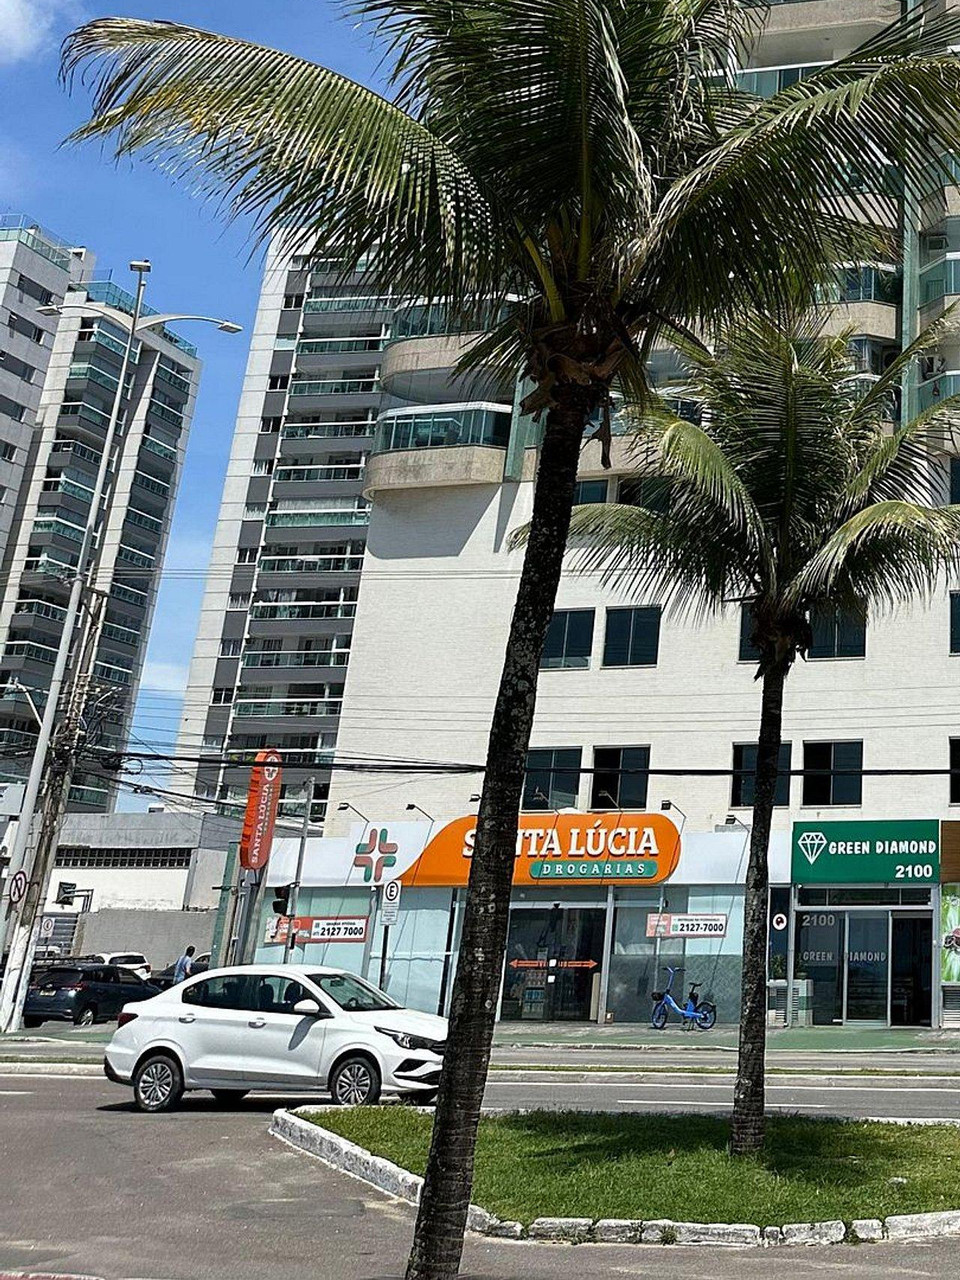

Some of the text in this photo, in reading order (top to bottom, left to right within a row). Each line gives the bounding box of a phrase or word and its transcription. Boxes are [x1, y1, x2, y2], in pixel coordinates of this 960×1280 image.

[251, 822, 264, 863] SANTA
[258, 783, 270, 820] LÚCIA
[462, 820, 659, 856] STA LÚCIA
[828, 840, 937, 854] GREEN DIAMOND
[542, 863, 646, 875] DROGARIAS
[895, 864, 933, 878] 2100
[388, 885, 396, 897] E
[802, 914, 835, 927] 2100
[320, 927, 341, 936] 2127
[343, 927, 364, 936] 7000
[803, 951, 833, 961] GREEN
